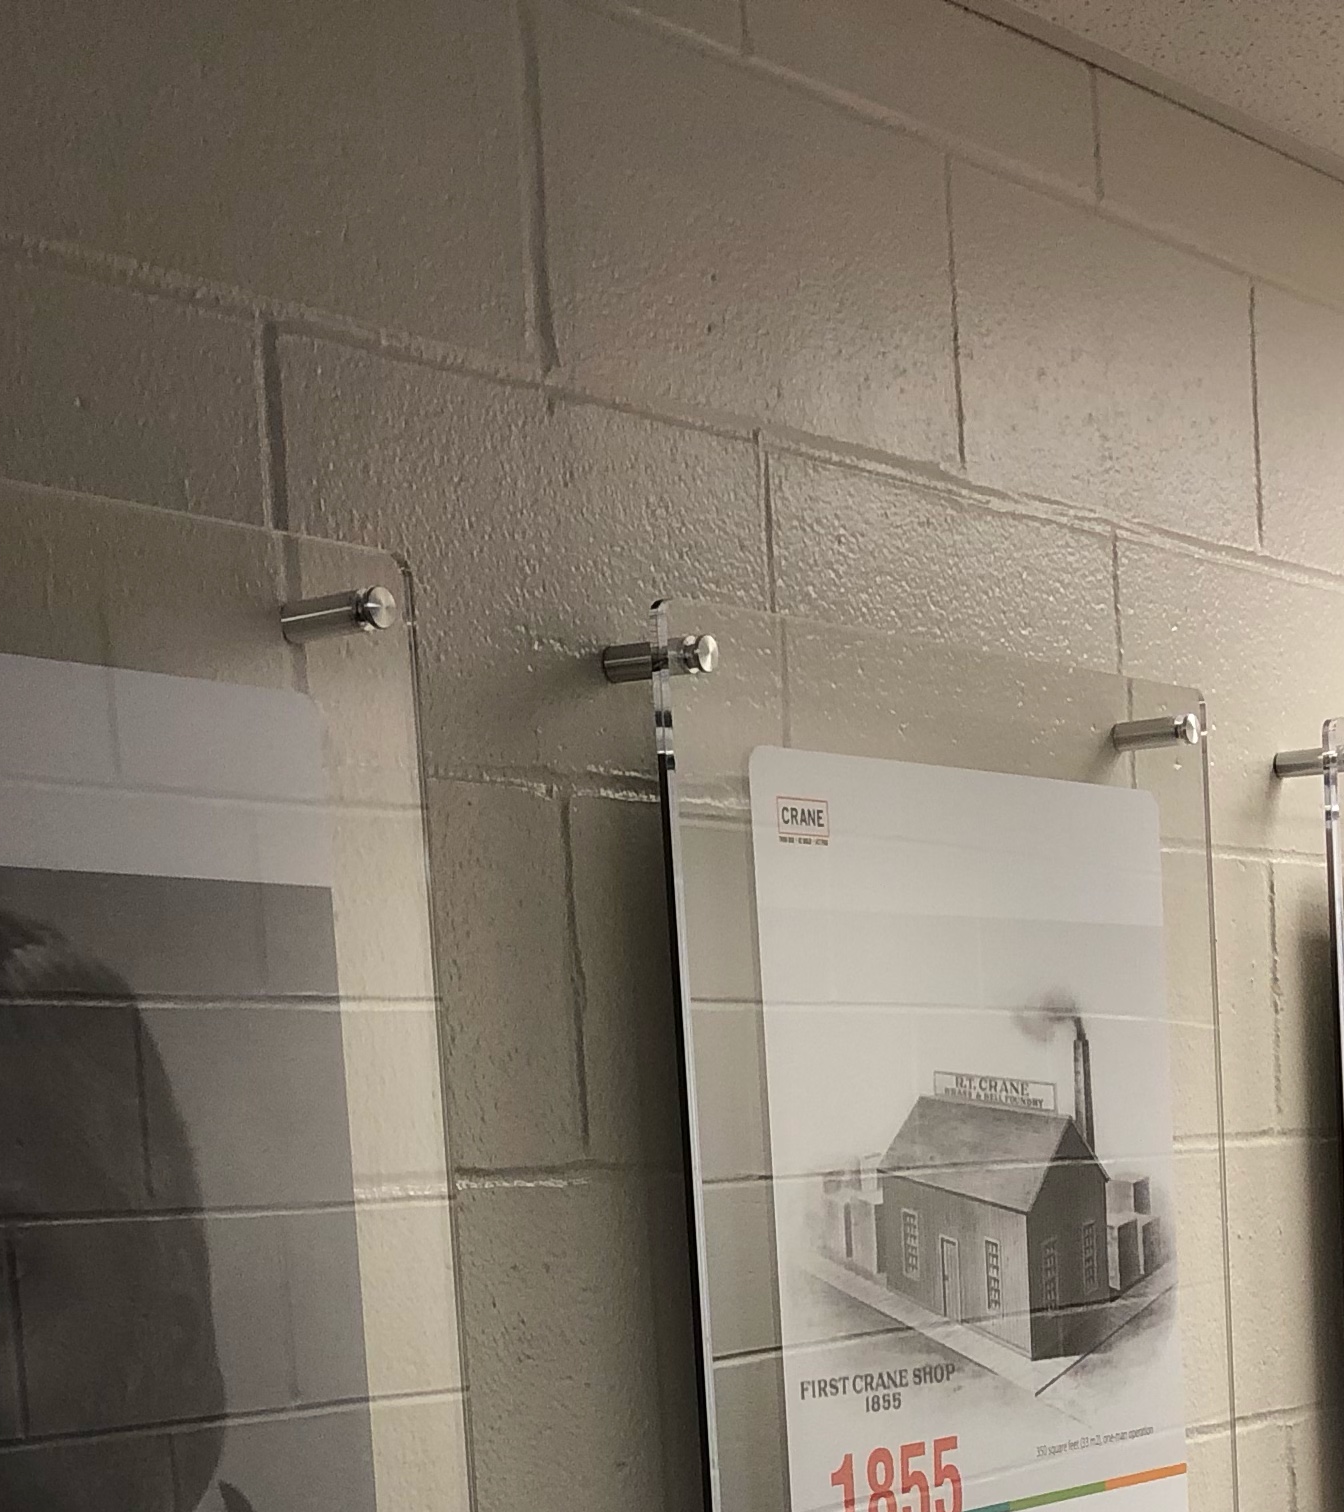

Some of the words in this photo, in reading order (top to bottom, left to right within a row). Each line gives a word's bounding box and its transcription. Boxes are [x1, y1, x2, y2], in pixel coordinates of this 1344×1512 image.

[781, 806, 825, 828] CRANE
[800, 1376, 849, 1401] FIRST
[852, 1369, 909, 1394] CRANE
[912, 1363, 957, 1386] SHOP
[865, 1392, 902, 1413] 1855
